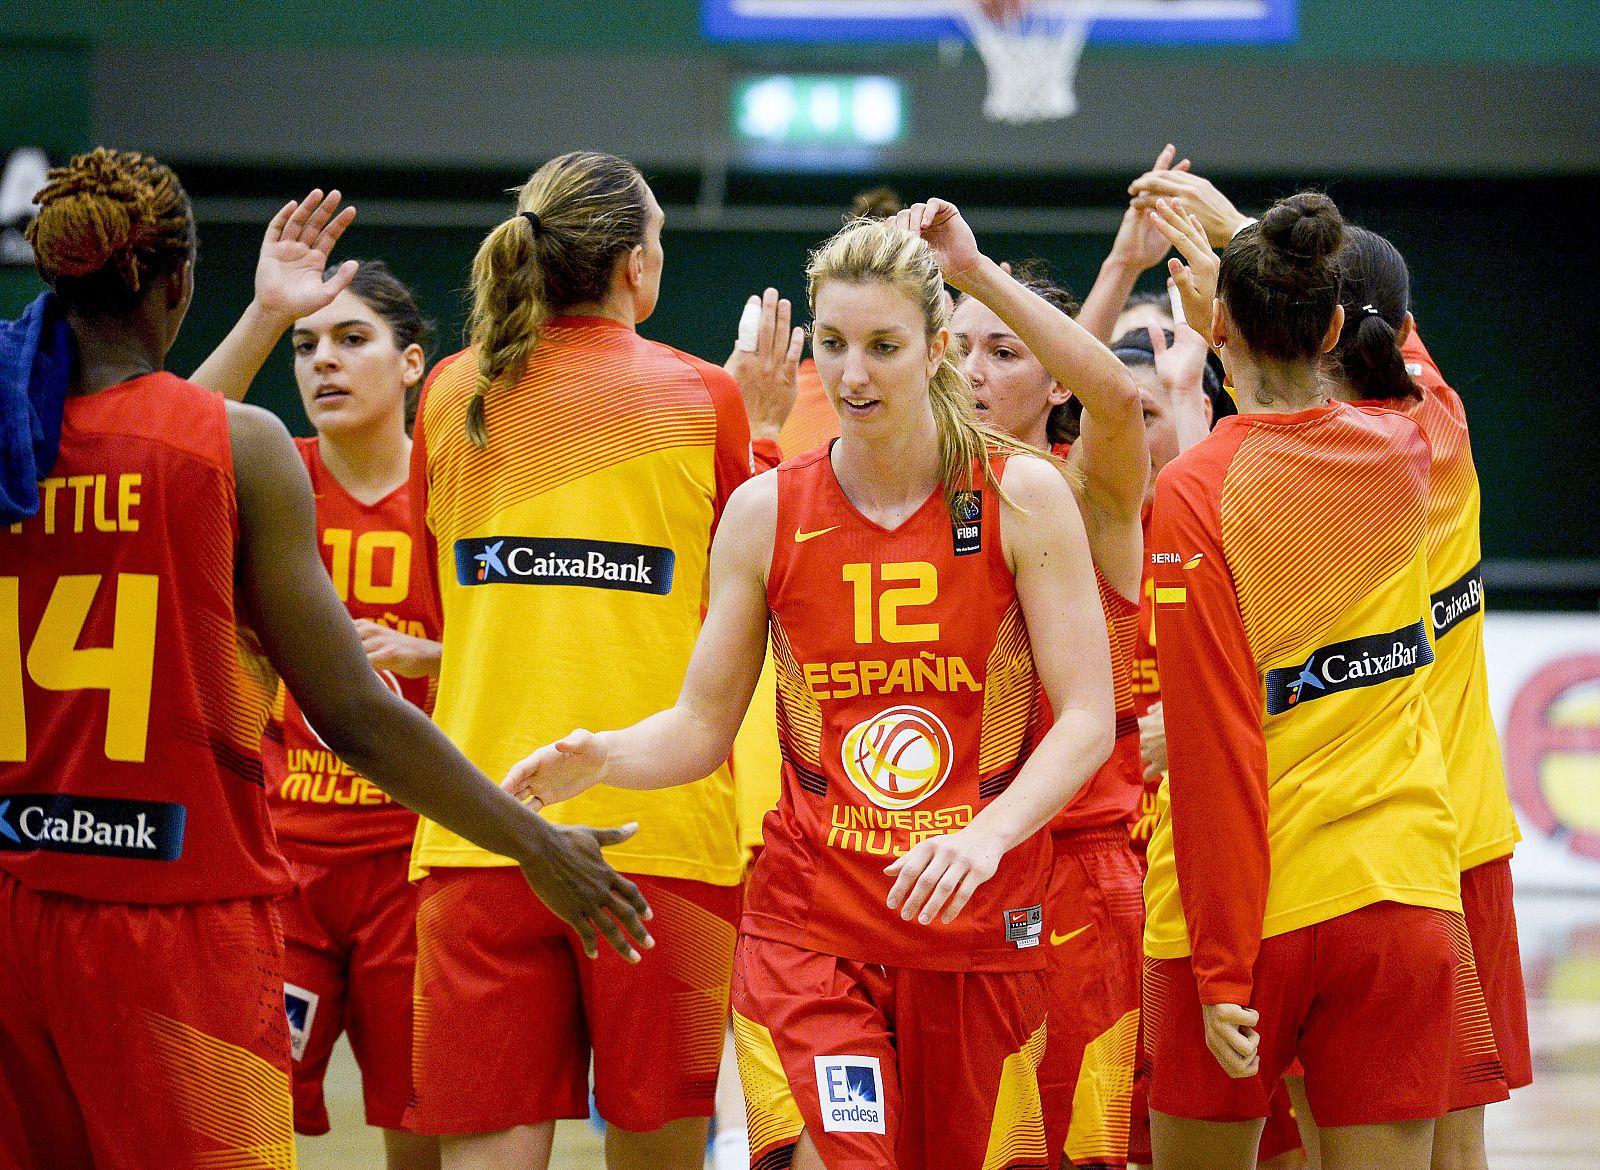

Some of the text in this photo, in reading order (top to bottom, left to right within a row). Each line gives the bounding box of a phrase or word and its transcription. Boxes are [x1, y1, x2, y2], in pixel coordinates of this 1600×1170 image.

[10, 473, 142, 534] TTLE
[957, 526, 978, 539] FIBA
[322, 528, 412, 604] 10
[507, 547, 652, 584] CaixaBank
[1152, 553, 1182, 564] BERIA
[842, 561, 940, 643] 12
[803, 650, 983, 701] ESPAÑA
[280, 772, 393, 805] MUJE
[831, 804, 973, 830] UNIVERSO
[831, 1104, 879, 1123] endesa
